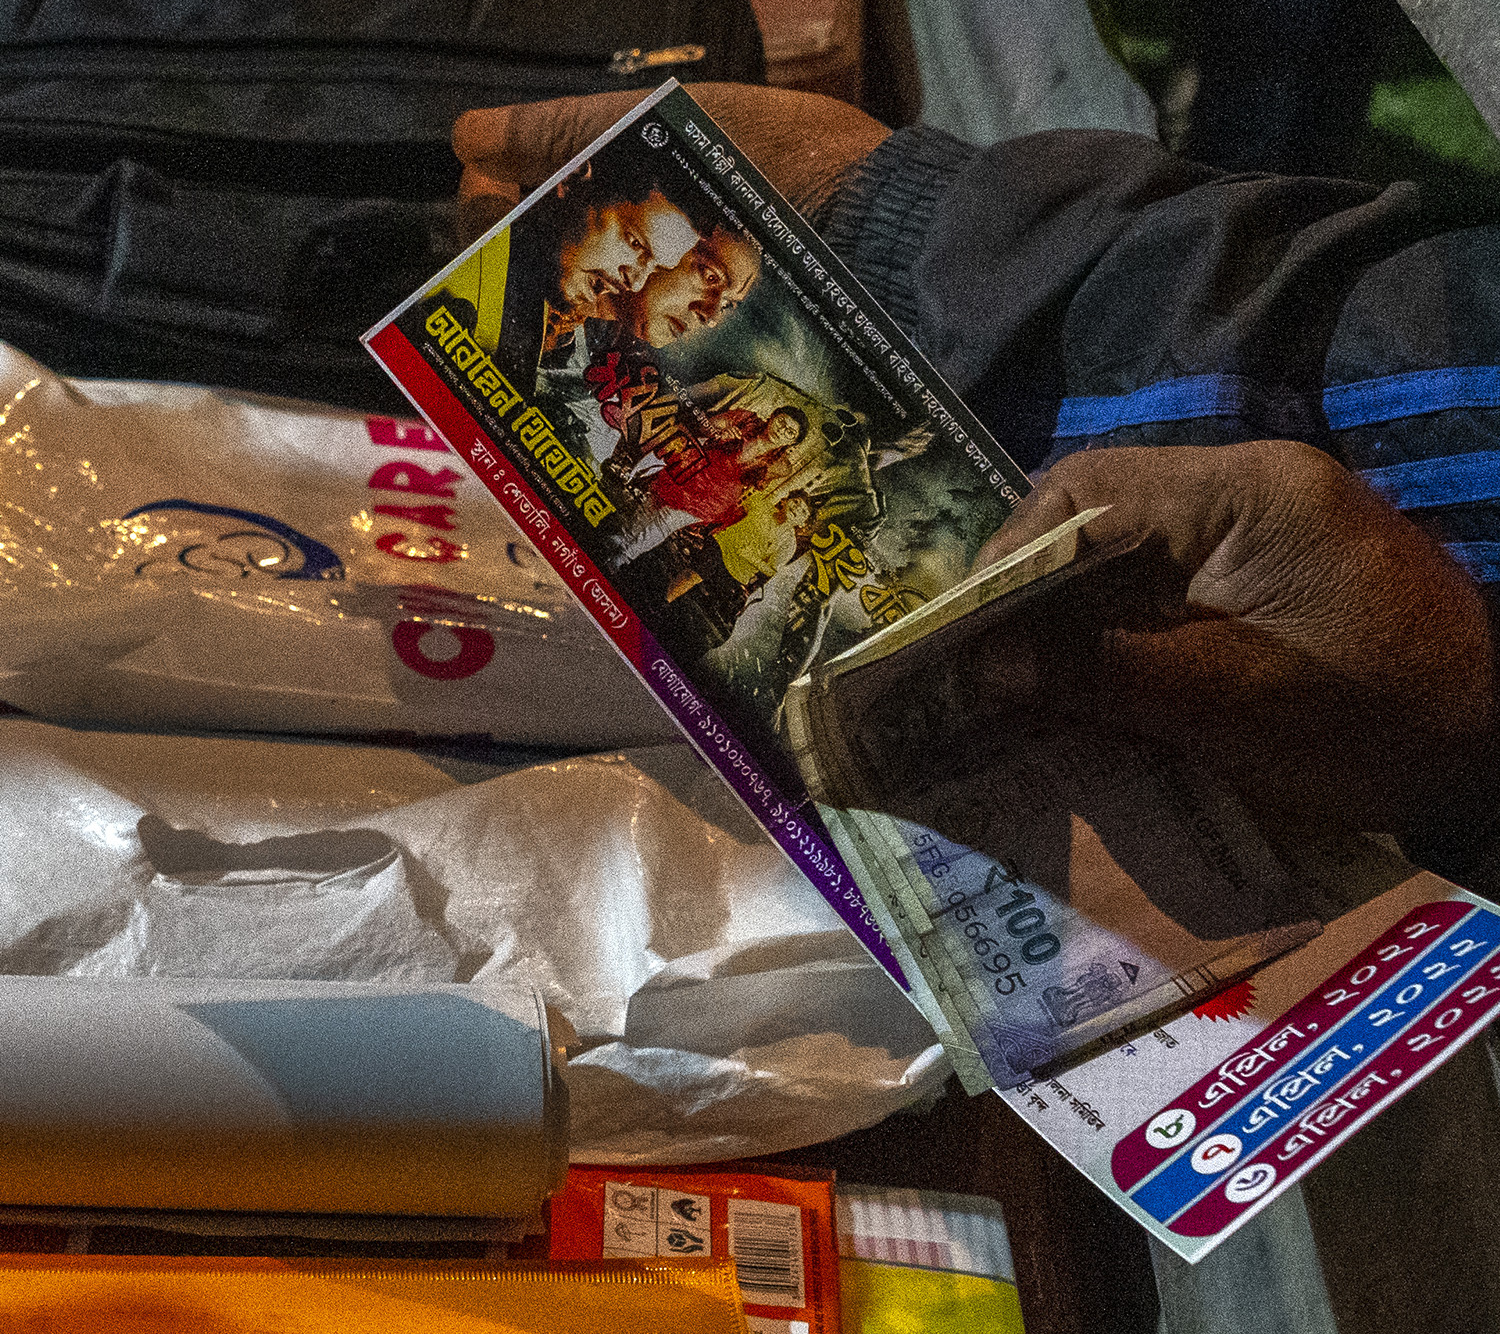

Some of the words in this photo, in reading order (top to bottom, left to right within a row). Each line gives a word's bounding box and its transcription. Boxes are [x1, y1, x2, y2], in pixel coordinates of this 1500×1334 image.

[681, 121, 709, 149] অসম
[705, 145, 735, 175] শিল্পী
[727, 172, 764, 210] কাননৰ
[758, 206, 806, 255] উদ্যোগত
[798, 252, 827, 281] আৰু
[851, 312, 891, 353] অঞ্চলৰ
[885, 351, 925, 392] ৰাইজৰ
[918, 390, 968, 443] সহযোগত
[961, 441, 991, 471] অসম
[366, 415, 462, 563] CARE
[466, 440, 495, 471] স্থান
[550, 535, 589, 577] নগাঁও
[581, 577, 628, 630] (অসম)
[1190, 1015, 1323, 1108] এপ্ৰিল,
[1316, 914, 1446, 1007] ২০২২
[1234, 1037, 1369, 1133] এপ্ৰিল,
[1362, 932, 1494, 1027] ২০২২
[1268, 1062, 1408, 1160] এপ্ৰিল,
